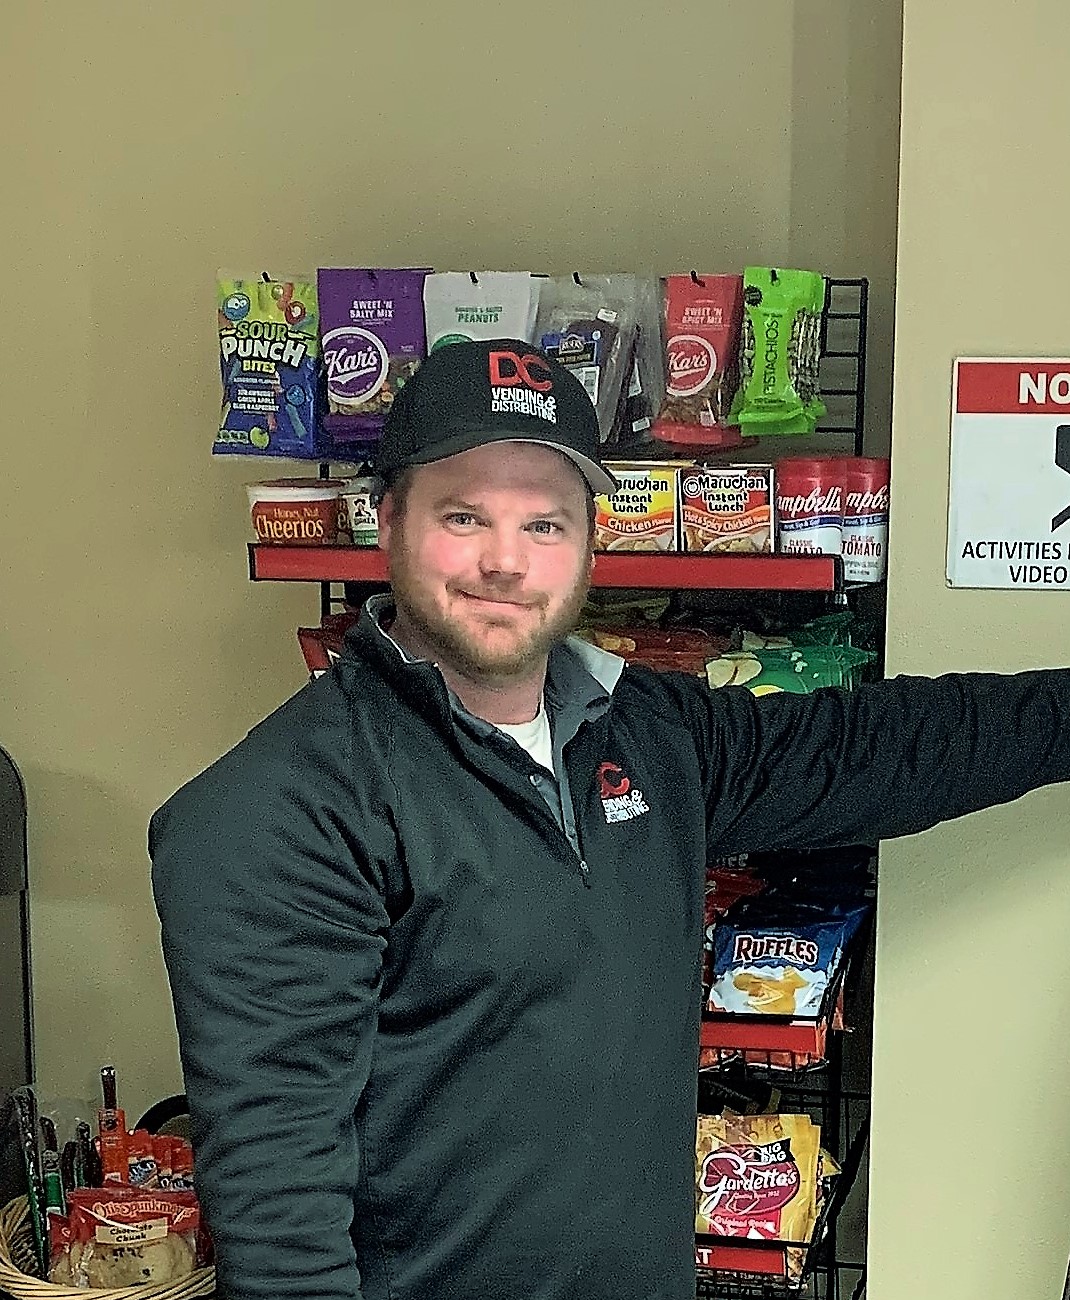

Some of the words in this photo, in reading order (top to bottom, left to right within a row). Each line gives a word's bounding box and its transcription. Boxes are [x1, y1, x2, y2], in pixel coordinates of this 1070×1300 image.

[349, 309, 375, 319] SALTY
[376, 309, 394, 318] MIX
[458, 313, 499, 323] PEANUTS
[236, 321, 288, 342] SOUR
[221, 336, 306, 367] PUNCH
[243, 360, 275, 373] BITES
[324, 345, 378, 379] Kar's
[668, 351, 708, 371] Kar's
[489, 350, 552, 392] DC
[491, 387, 543, 407] VENDING
[492, 400, 556, 424] DISTRIBUTING
[616, 477, 668, 492] aruchan
[700, 475, 764, 491] Maruchan
[704, 492, 748, 502] Instant
[273, 507, 299, 519] Honey
[613, 502, 648, 513] Lunch
[709, 501, 744, 511] Lunch
[256, 514, 324, 539] Cheerios
[608, 518, 651, 531] Chicken
[684, 511, 698, 523] Hot
[702, 516, 722, 532] Spicy
[722, 516, 753, 532] Chicken
[842, 541, 881, 557] TOMATO
[961, 541, 1062, 560] ACTIVITIES
[1009, 564, 1068, 584] VIDEO
[733, 934, 819, 966] RUFFLES
[761, 1142, 782, 1155] BIG
[761, 1152, 787, 1163] BAG
[700, 1152, 797, 1216] Gardetto's
[93, 1202, 119, 1218] Otis
[116, 1233, 147, 1243] Chunk
